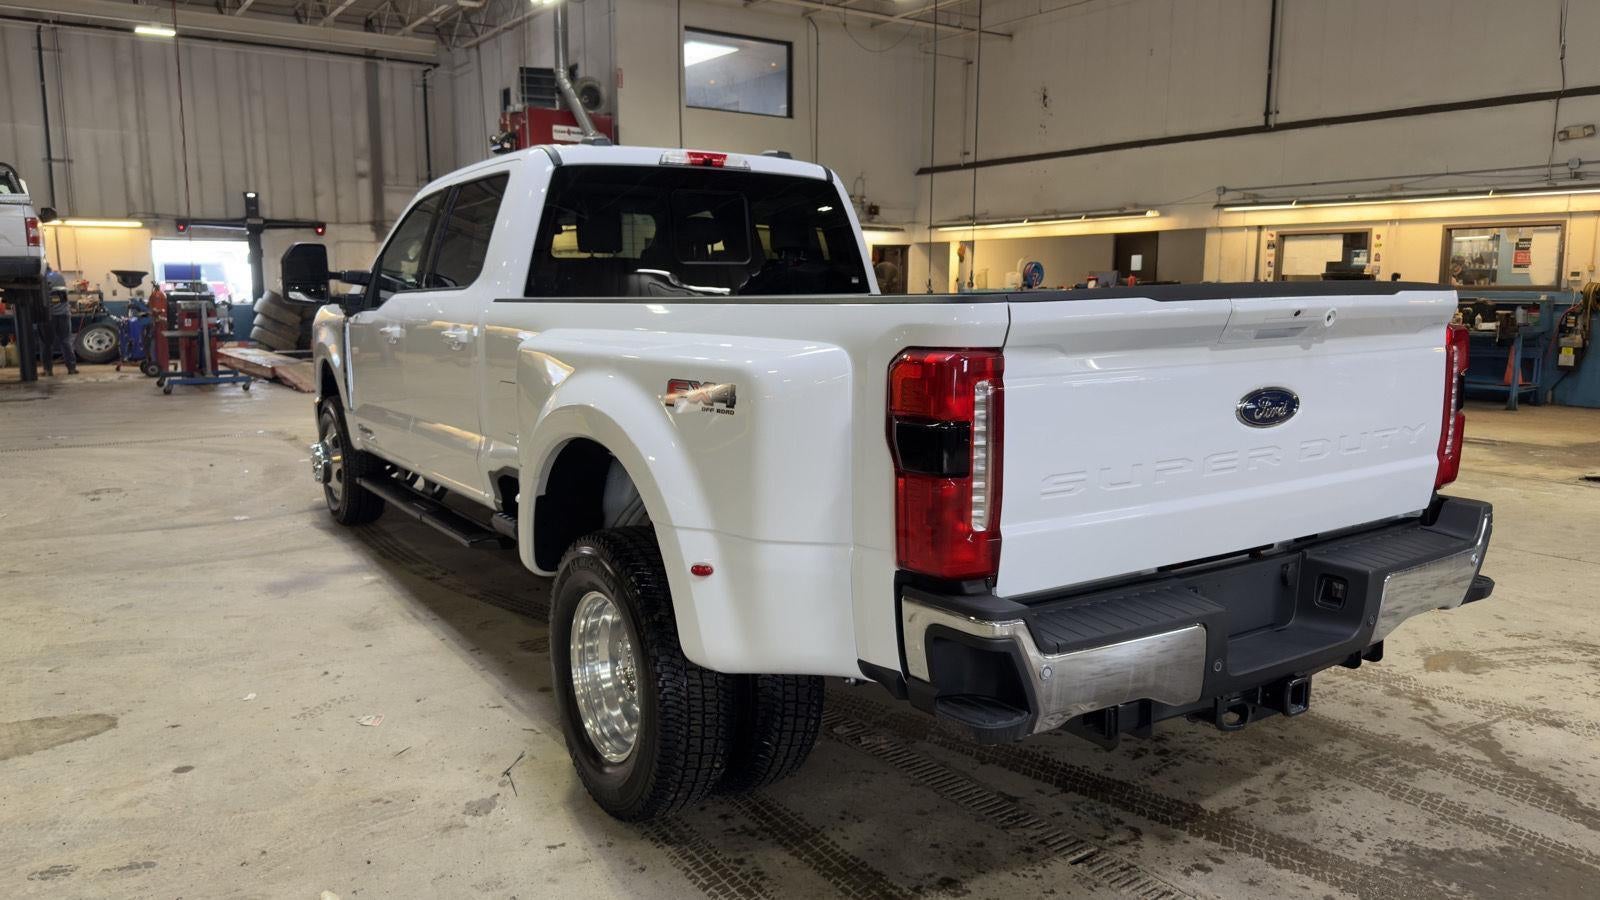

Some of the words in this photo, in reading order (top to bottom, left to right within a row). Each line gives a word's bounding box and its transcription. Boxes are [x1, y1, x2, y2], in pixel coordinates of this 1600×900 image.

[665, 379, 736, 408] FX4
[716, 408, 735, 416] ROAD
[1254, 397, 1288, 420] Ford
[1040, 445, 1282, 499] SUPER
[1298, 422, 1427, 463] DUTY
